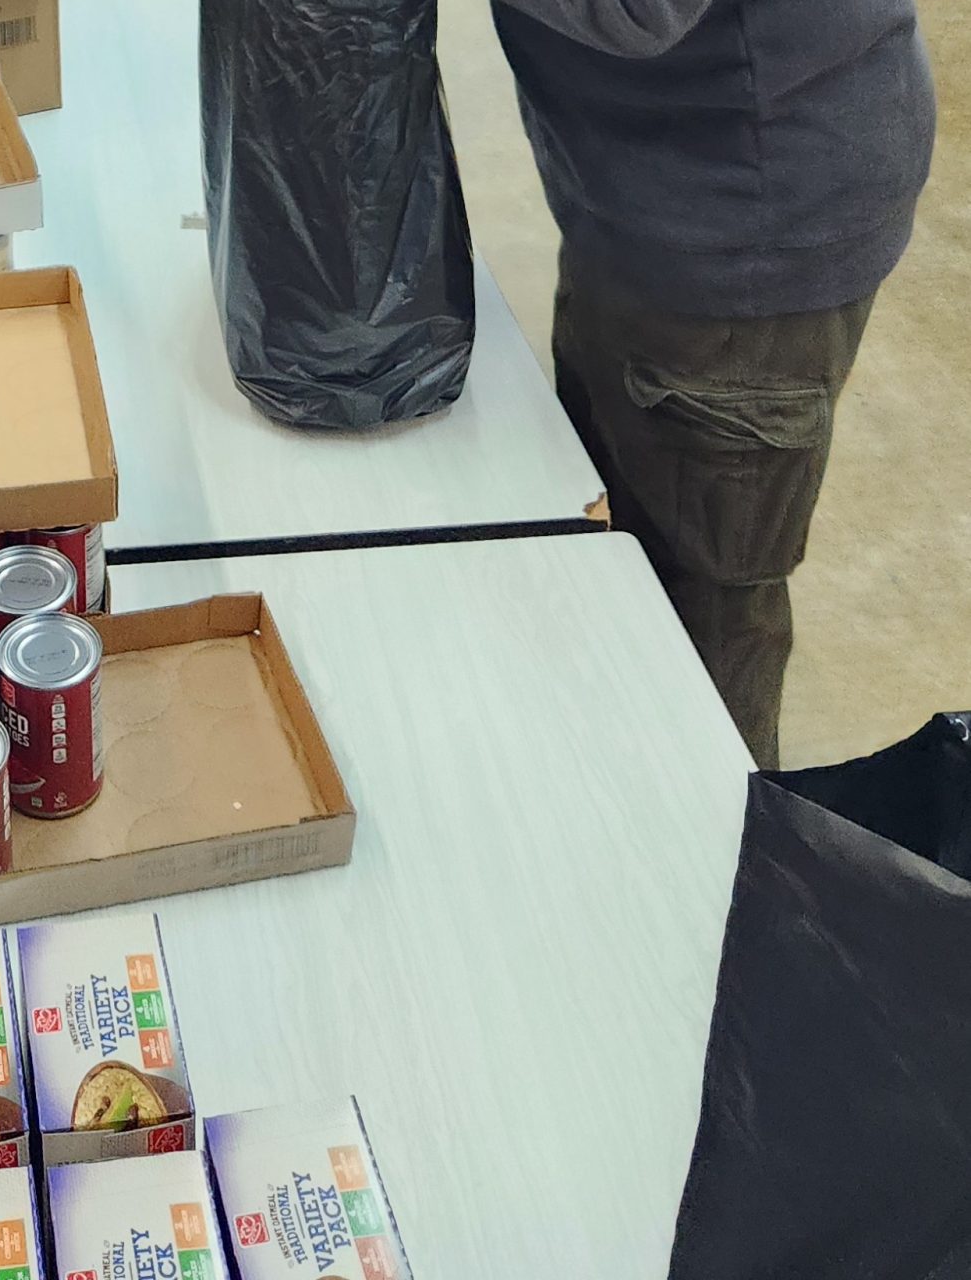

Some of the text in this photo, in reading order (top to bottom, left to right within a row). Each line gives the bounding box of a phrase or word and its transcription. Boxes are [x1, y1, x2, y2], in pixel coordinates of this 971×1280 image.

[1, 701, 29, 735] CED
[75, 984, 95, 1050] TRADITIONAL
[90, 973, 118, 1057] VARIETY
[112, 985, 135, 1038] PACK
[267, 1193, 292, 1259] INSTANT OATMEAL
[276, 1185, 308, 1265] TRADITIONAL
[292, 1171, 335, 1272] VARIETY
[317, 1184, 352, 1249] PACK
[131, 1228, 157, 1280] IETY
[154, 1243, 177, 1280] CK
